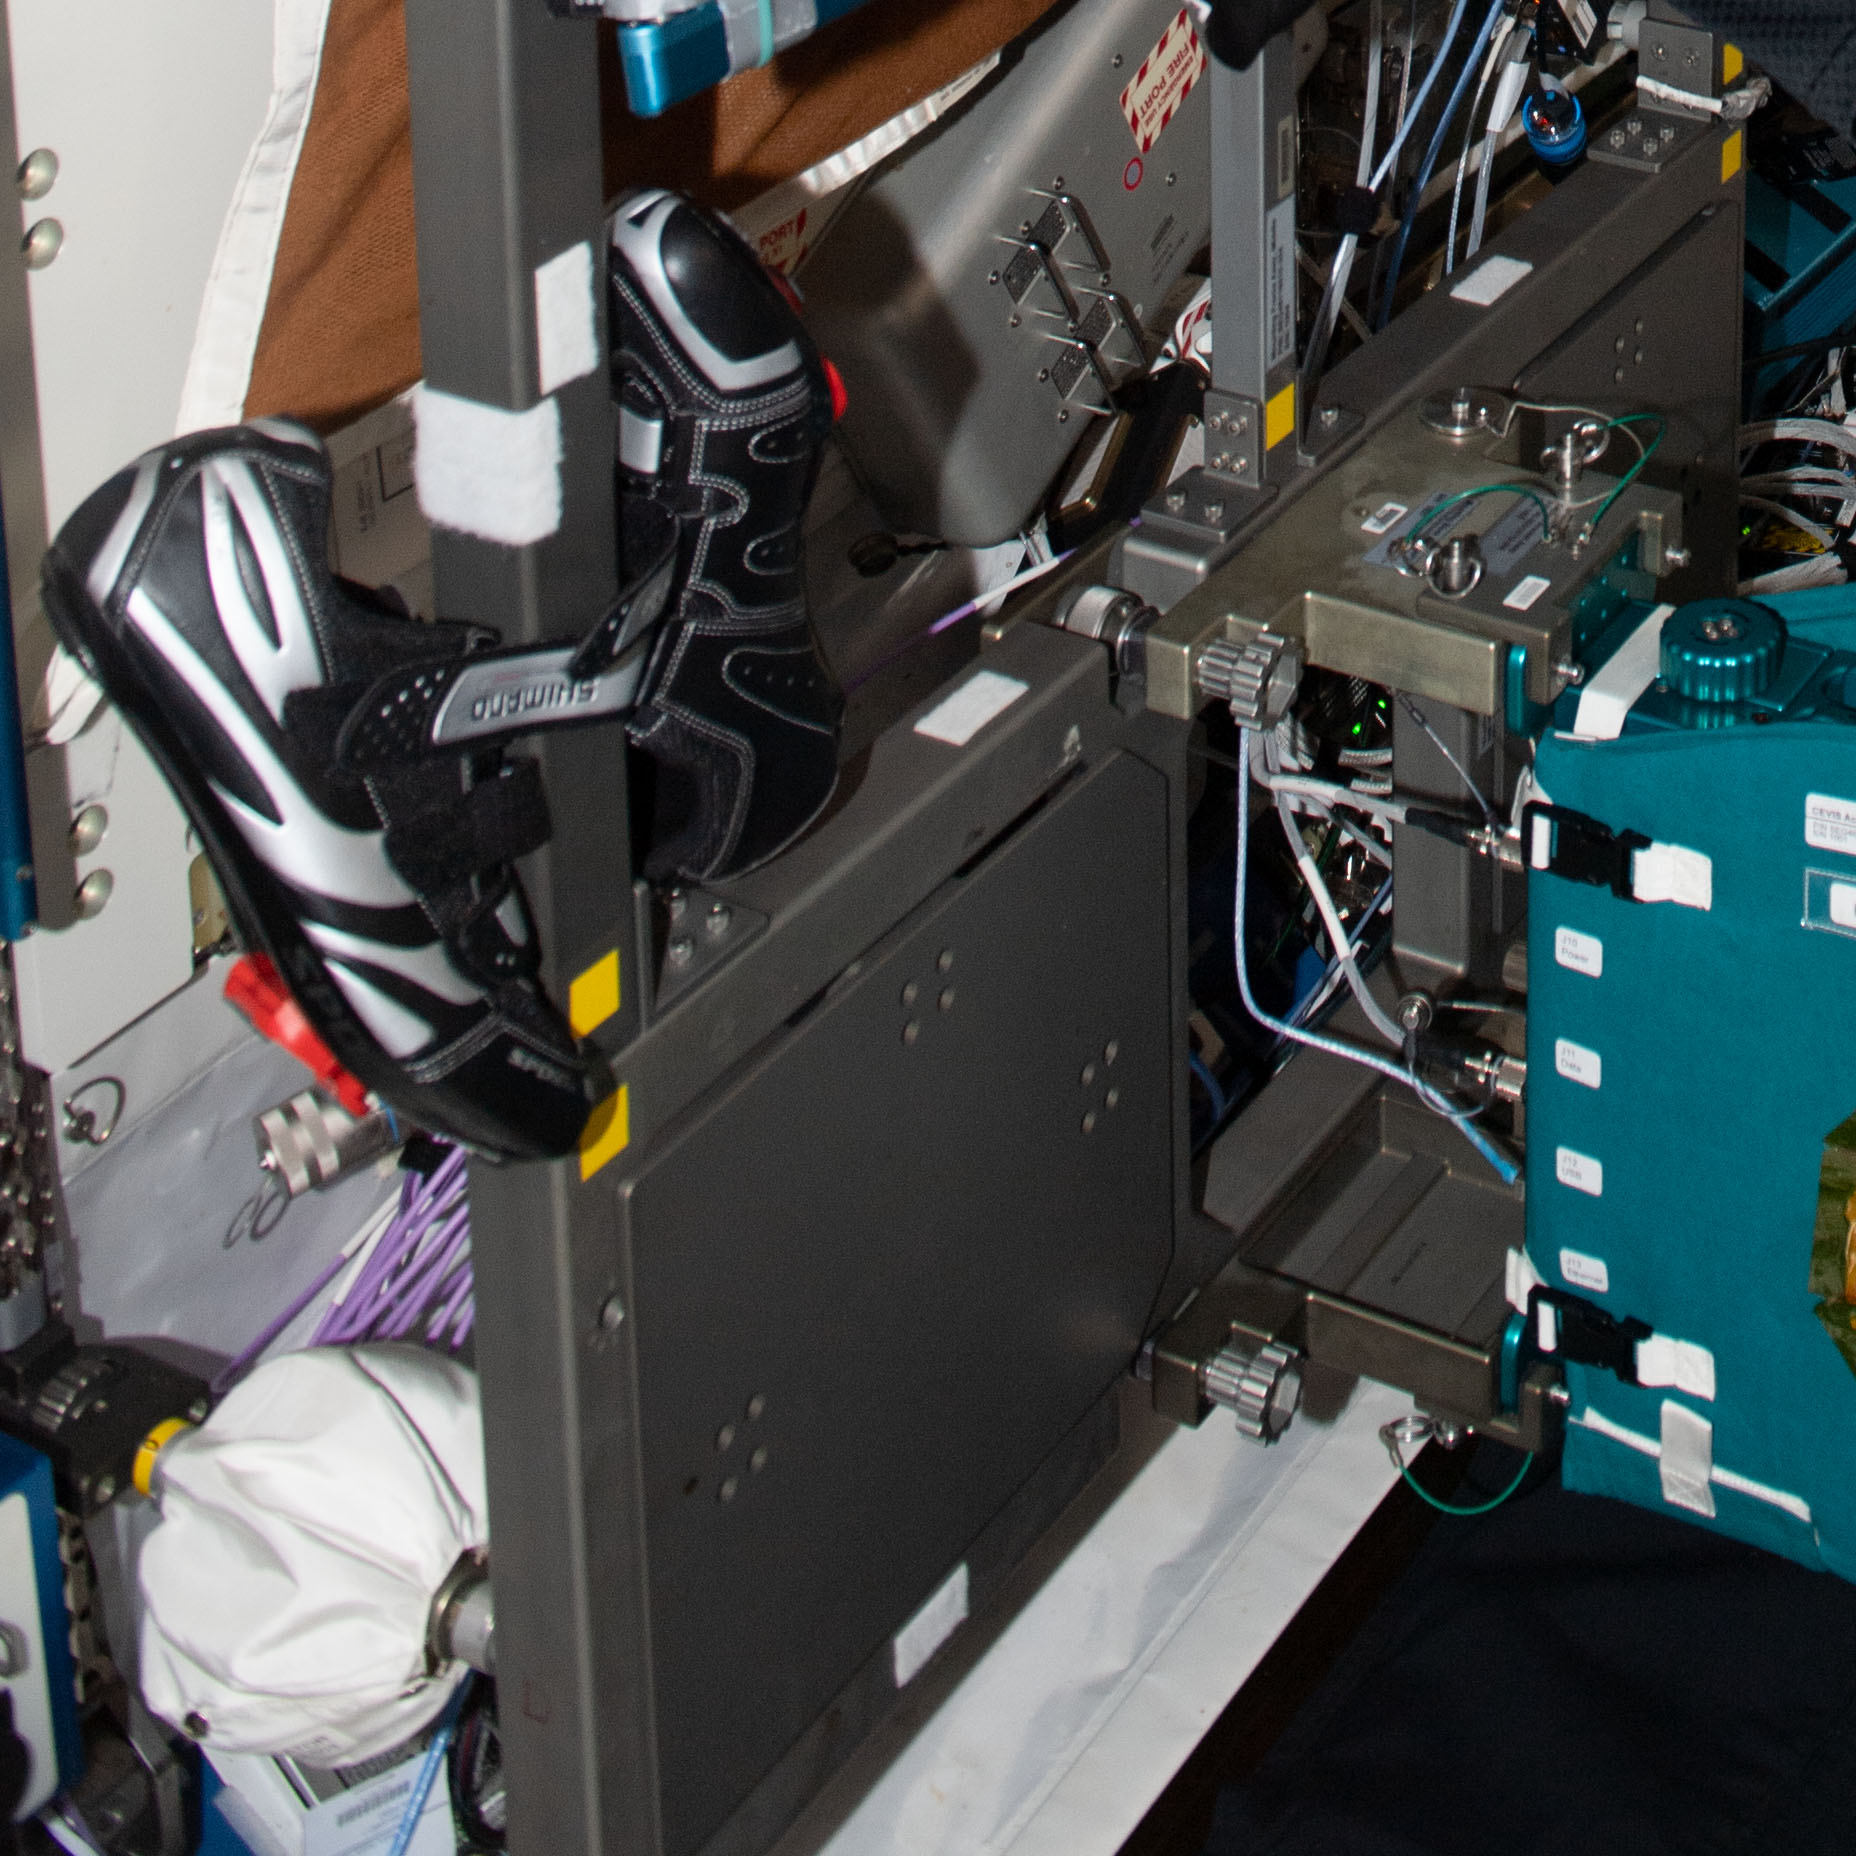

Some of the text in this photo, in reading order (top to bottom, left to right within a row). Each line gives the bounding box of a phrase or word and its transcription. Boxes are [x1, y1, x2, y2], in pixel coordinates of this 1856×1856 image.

[1139, 41, 1191, 119] FIRE PORT
[1157, 54, 1194, 108] EMERGENCY
[470, 675, 601, 722] SHIMANO
[1811, 805, 1842, 821] CEVIS
[1560, 946, 1589, 963] Power
[1560, 1056, 1582, 1074] Data
[1561, 1165, 1583, 1182] USB
